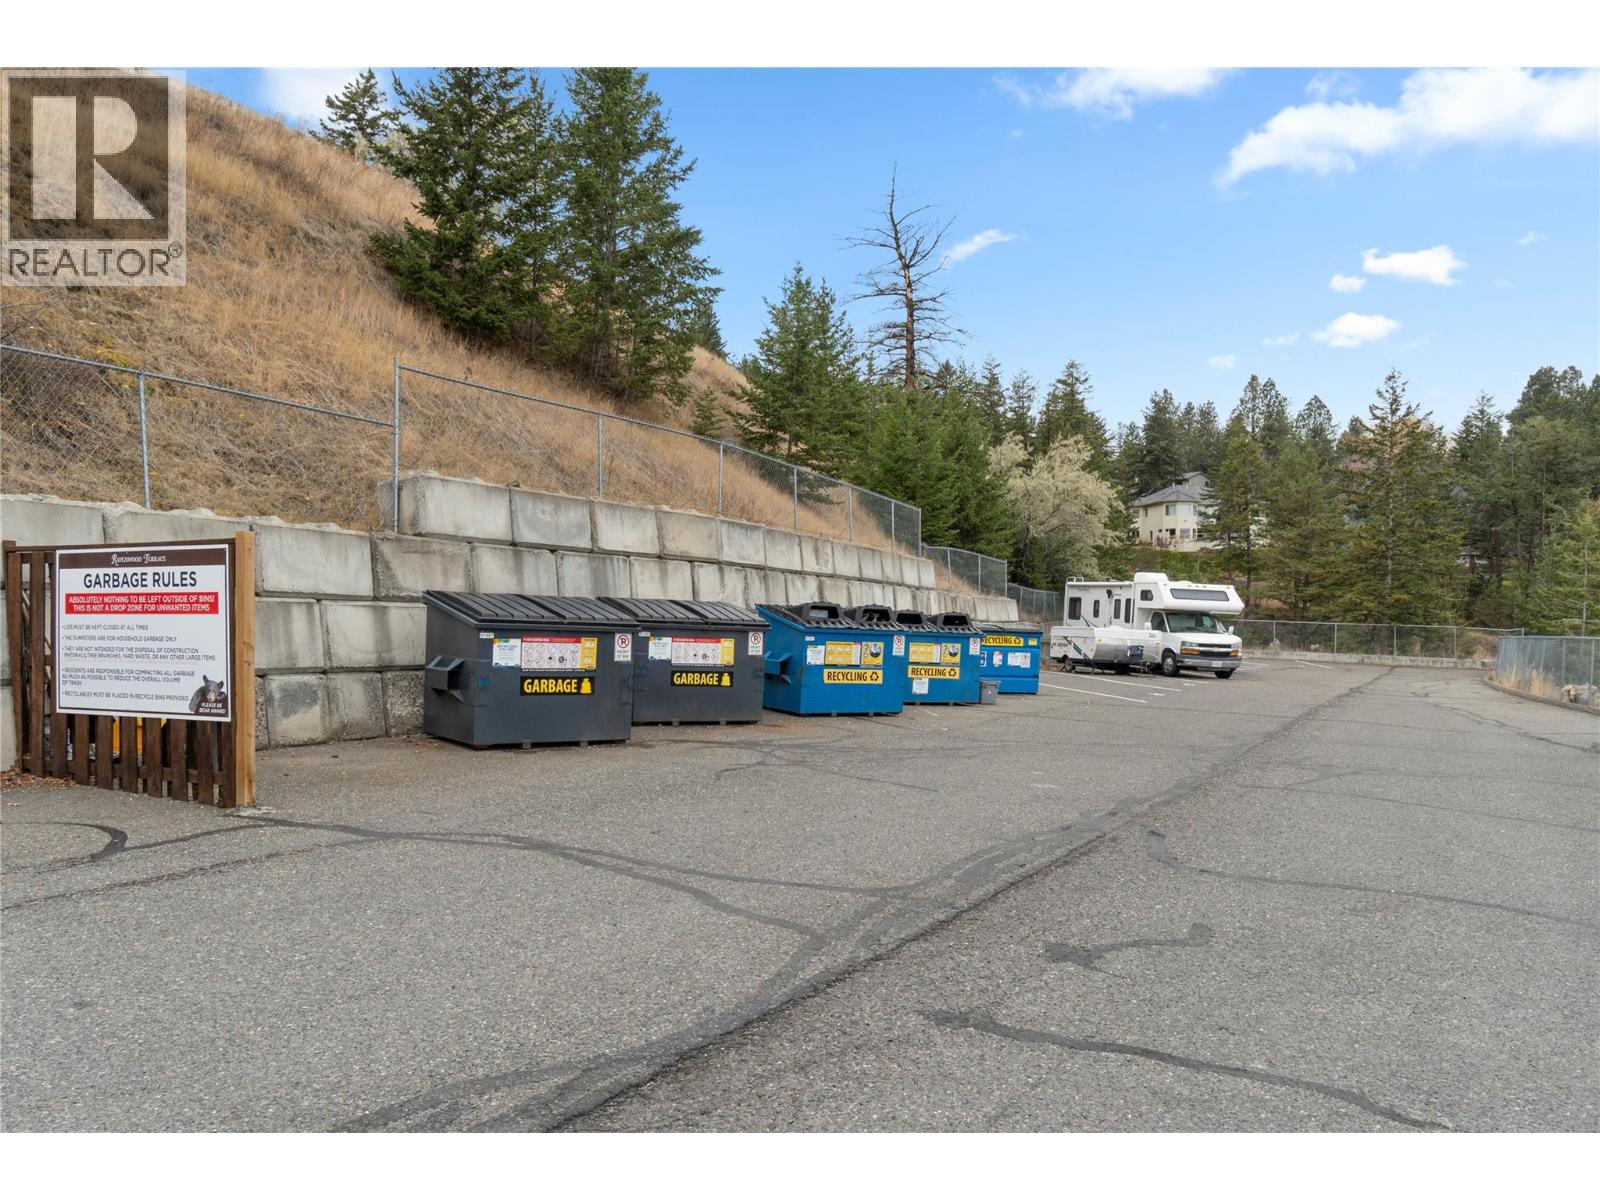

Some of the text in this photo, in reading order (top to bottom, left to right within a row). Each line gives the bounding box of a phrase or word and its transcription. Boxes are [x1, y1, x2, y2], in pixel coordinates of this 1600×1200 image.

[84, 571, 197, 588] GARBAGE RULES
[130, 595, 137, 603] TO
[139, 595, 147, 603] BE
[148, 595, 161, 603] LEFT
[73, 604, 85, 612] THIS
[827, 671, 868, 681] RECYCLING
[911, 667, 947, 677] RECYCLING
[673, 672, 719, 685] GARBAGE
[524, 677, 578, 693] GARBAGE
